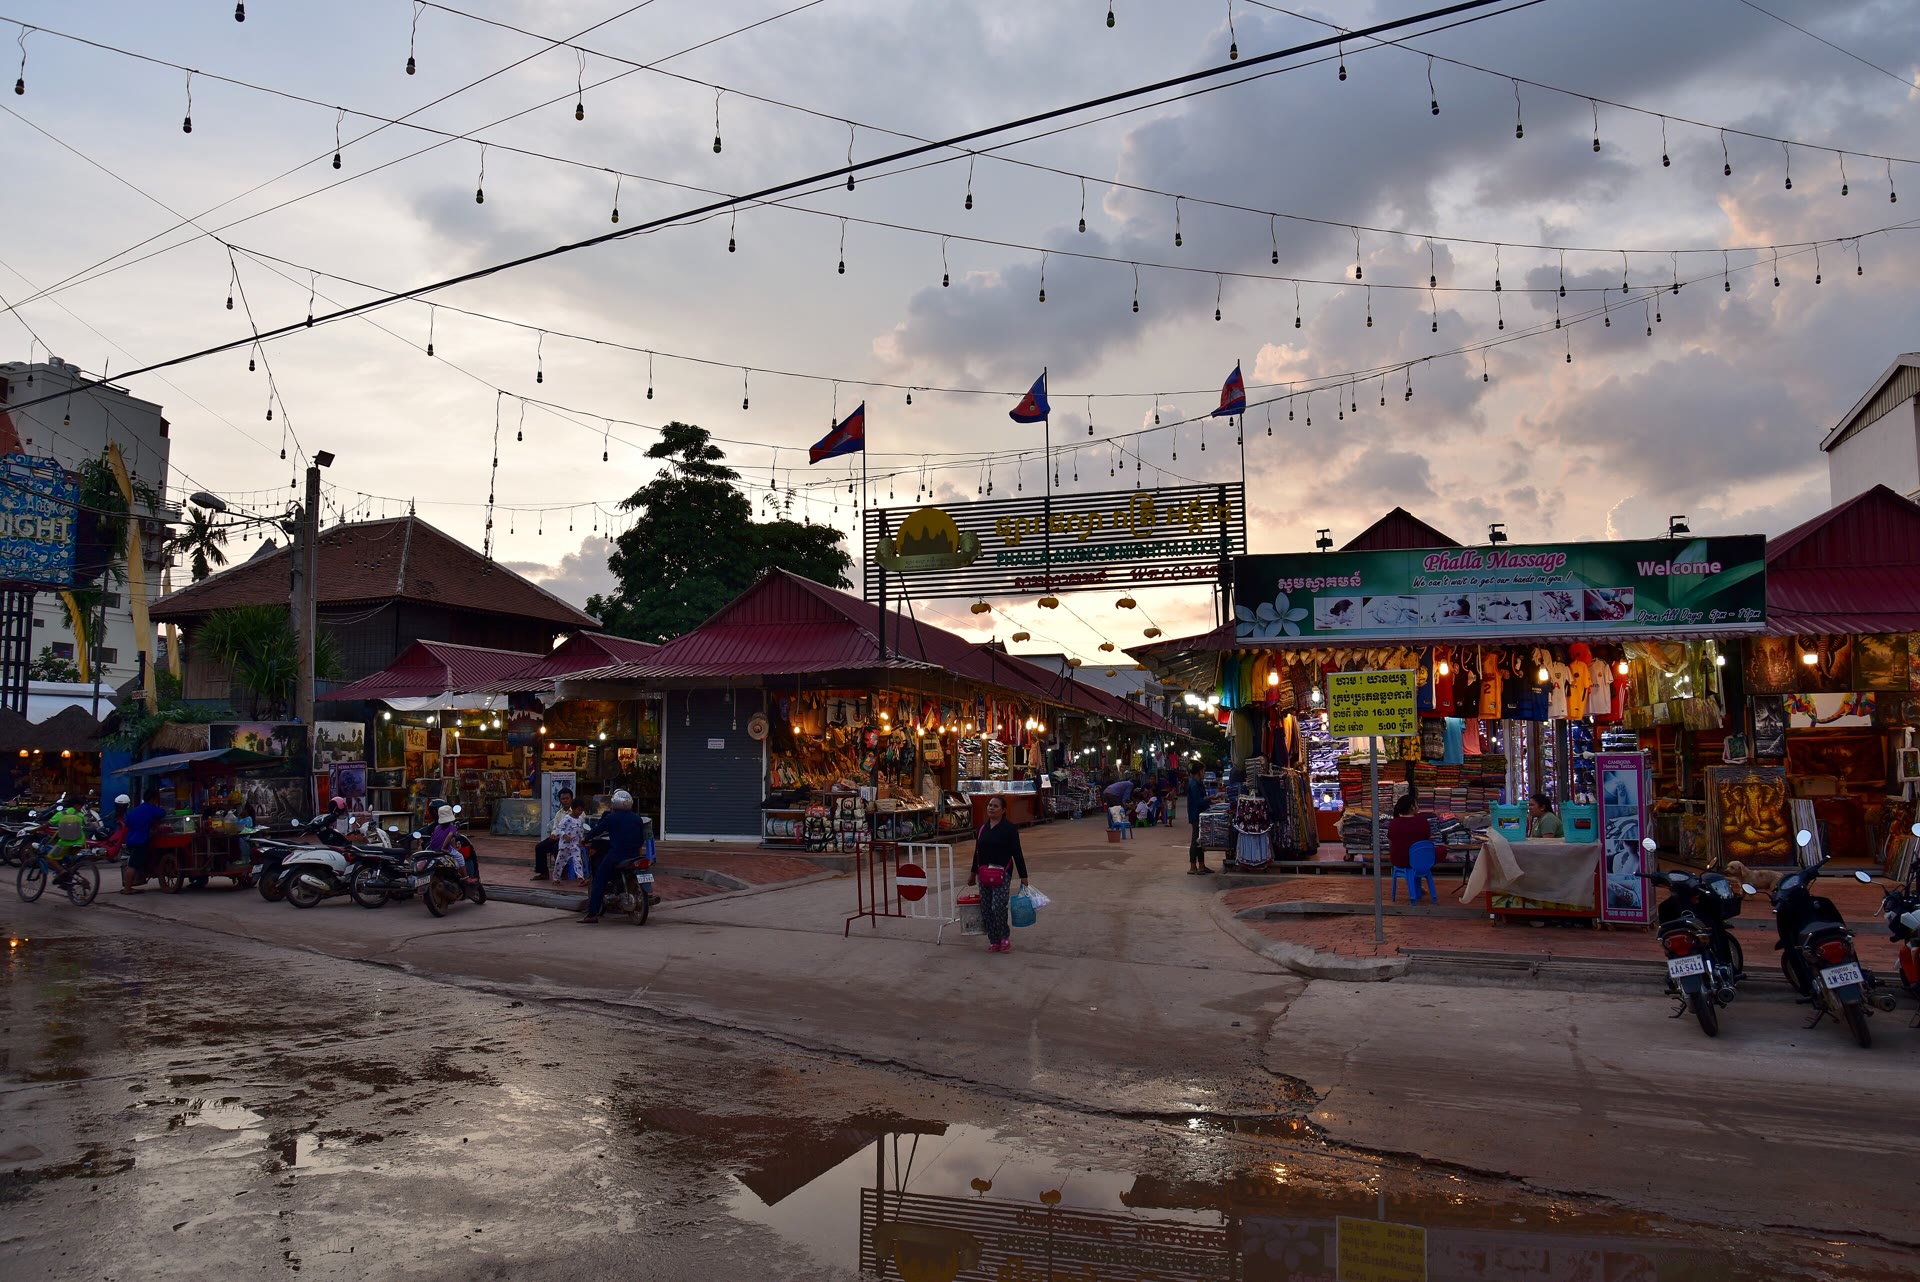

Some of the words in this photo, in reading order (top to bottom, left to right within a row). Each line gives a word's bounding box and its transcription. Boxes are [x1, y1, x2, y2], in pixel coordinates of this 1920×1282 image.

[996, 549, 1049, 567] PHALLA
[1050, 544, 1115, 564] ANGKOR
[1118, 541, 1164, 560] NIGHT
[1423, 552, 1481, 573] Phalla
[1486, 548, 1566, 573] Massage
[1636, 559, 1722, 577] Welcome
[1277, 569, 1362, 594] សូមស្វាគមន៍
[1413, 576, 1426, 588] We
[1428, 575, 1448, 587] can't
[1450, 577, 1468, 587] wait
[1470, 577, 1478, 585] to
[1478, 576, 1495, 588] get
[1496, 577, 1510, 585] our
[1512, 574, 1535, 584] hands
[1545, 576, 1562, 586] you
[1565, 570, 1573, 582] !
[1637, 609, 1658, 625] Open
[1660, 608, 1680, 621] All
[1679, 608, 1703, 624] Days
[1709, 609, 1727, 623] 5pm
[1738, 607, 1761, 622] 11pm
[1335, 676, 1357, 686] ហាម
[1483, 683, 1491, 694] 2
[1372, 708, 1395, 717] 16:30
[1378, 722, 1396, 730] 5:00
[1670, 962, 1703, 975] 1AA-5411
[1828, 971, 1858, 984] 1W-6278
